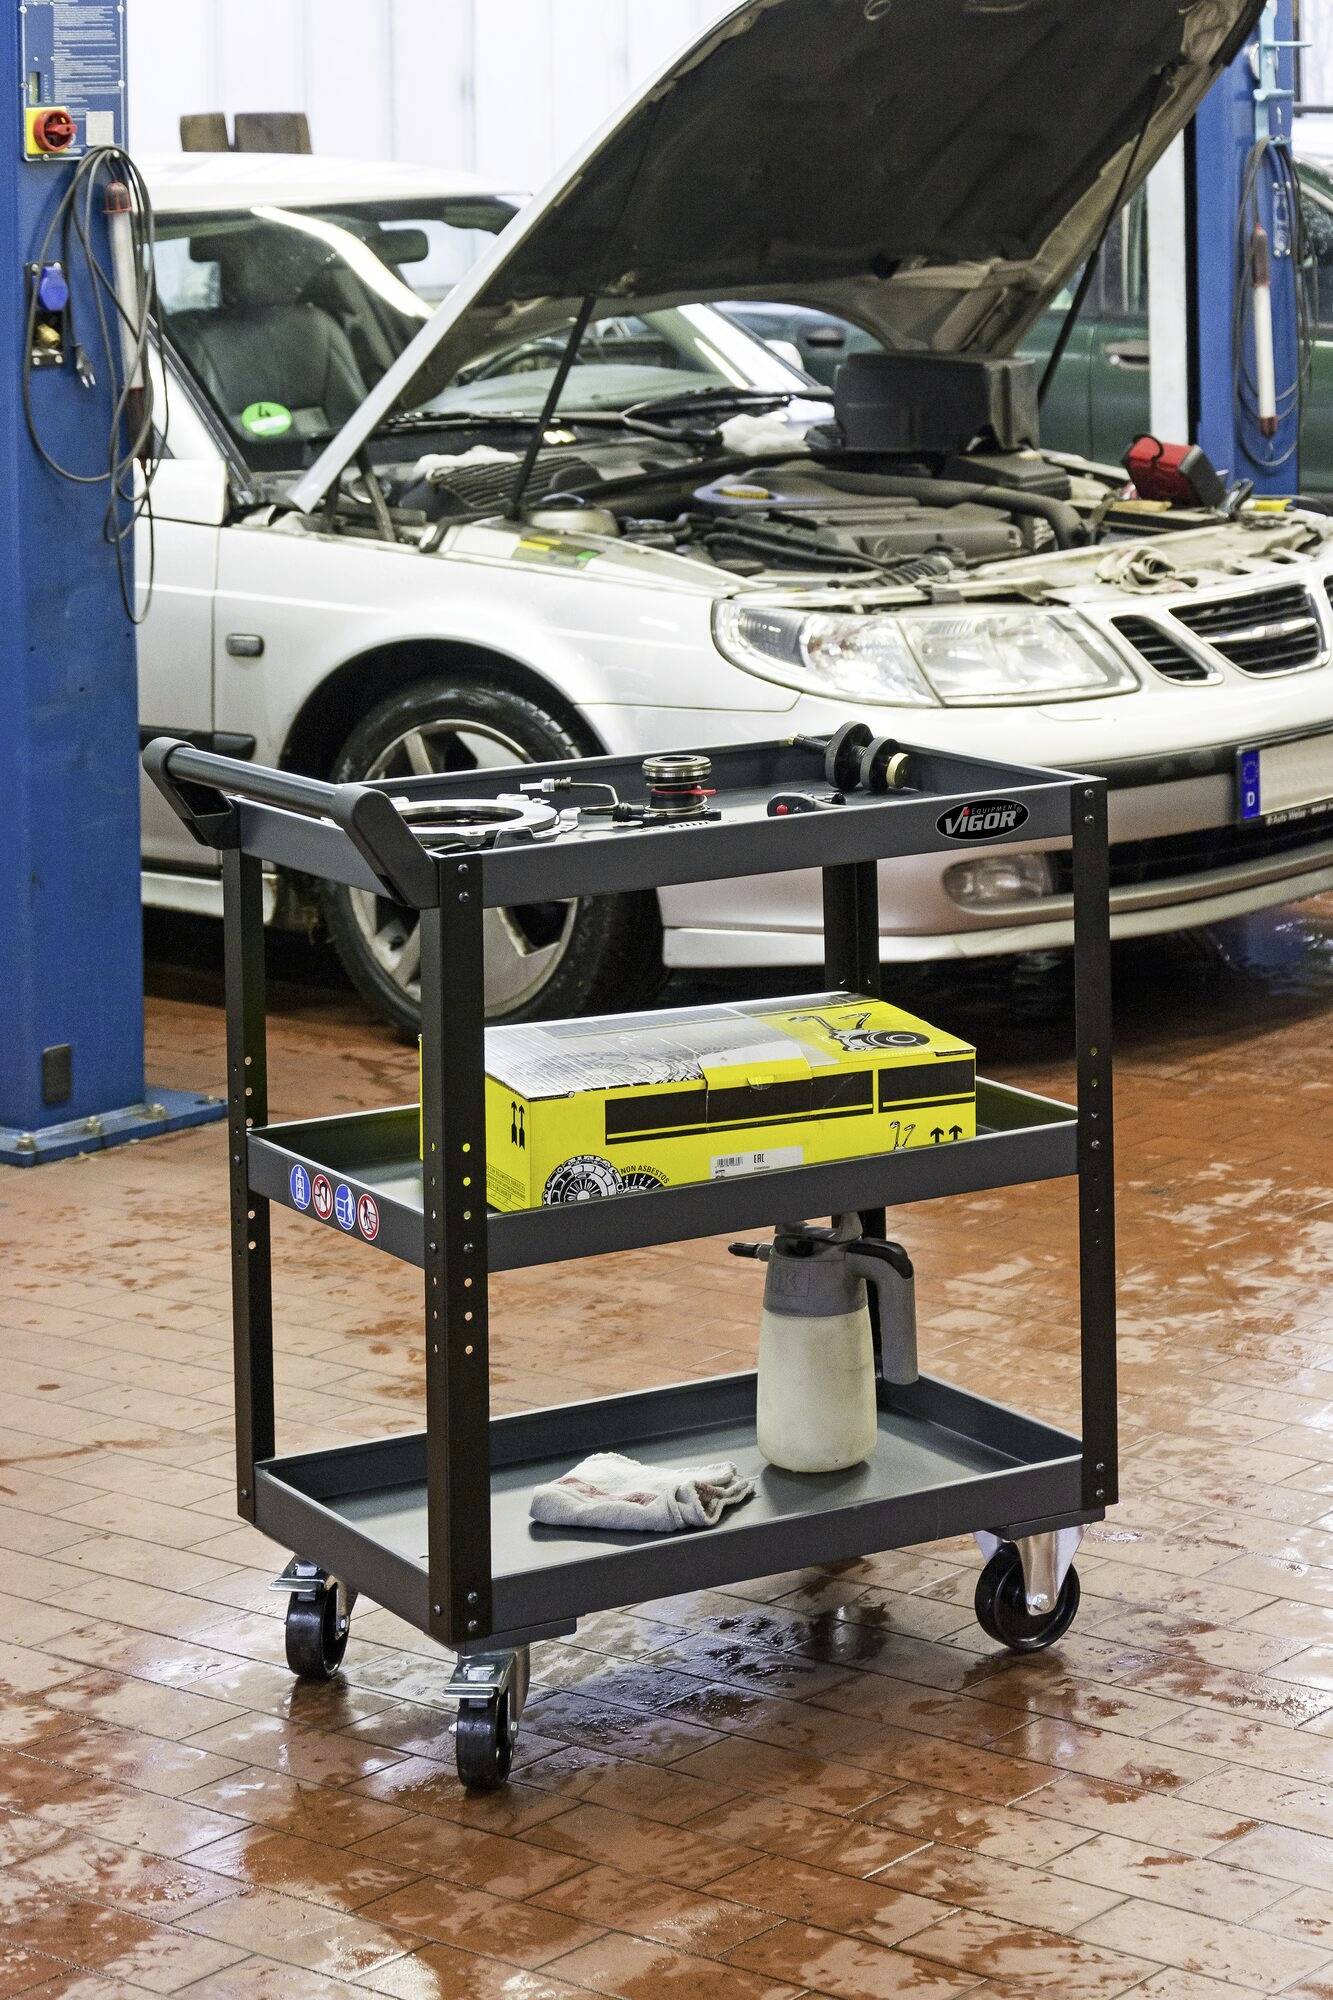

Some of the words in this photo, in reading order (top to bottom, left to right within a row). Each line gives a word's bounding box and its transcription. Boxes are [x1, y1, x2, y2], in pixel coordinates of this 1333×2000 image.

[1246, 791, 1255, 807] D
[945, 807, 1017, 835] VIGOR
[753, 1153, 765, 1164] EAC
[620, 1165, 637, 1175] NON
[637, 1165, 670, 1184] ASBESTOS
